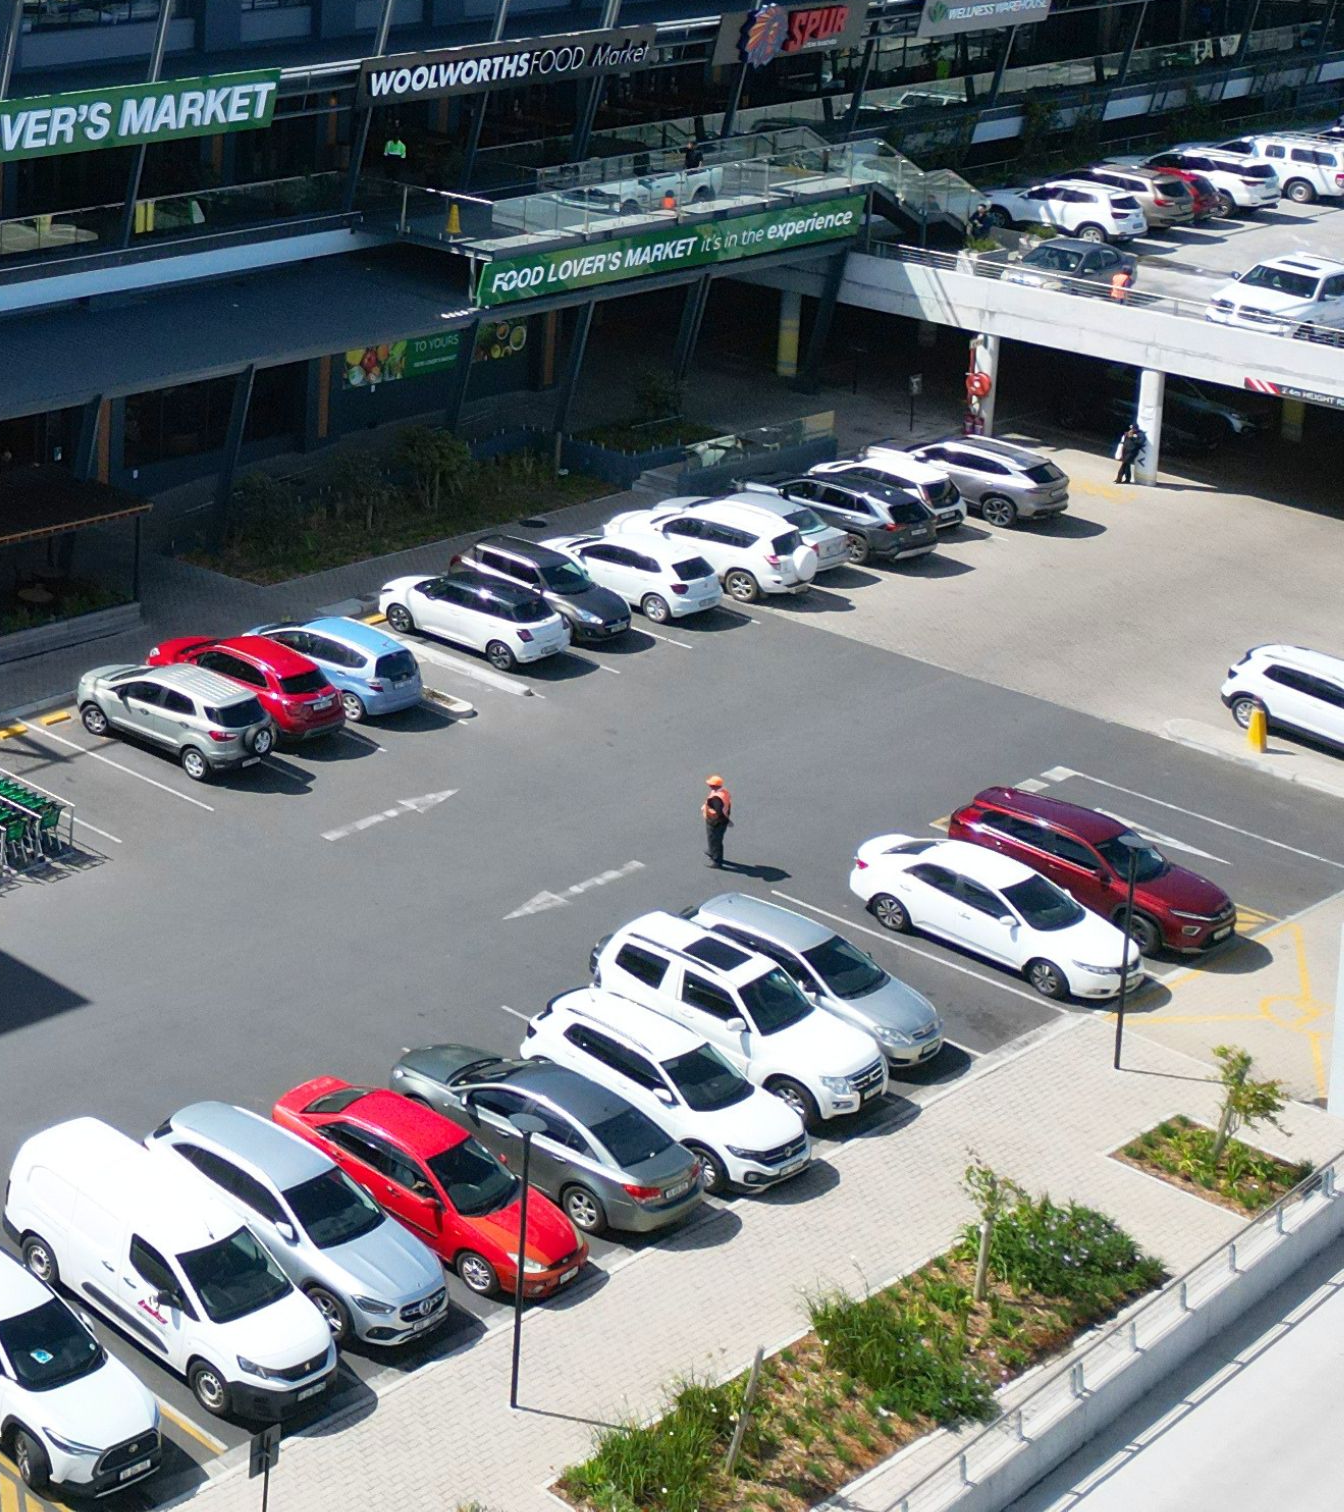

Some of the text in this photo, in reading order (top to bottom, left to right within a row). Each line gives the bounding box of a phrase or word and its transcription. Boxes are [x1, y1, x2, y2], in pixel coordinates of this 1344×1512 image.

[782, 5, 849, 52] SPUR
[948, 3, 995, 21] WELLNESS
[592, 41, 650, 66] Market
[118, 82, 276, 136] MARKET
[492, 266, 544, 293] FOOD
[547, 251, 622, 283] LOVER'S
[624, 237, 698, 268] MARKET
[724, 232, 738, 248] in
[741, 228, 763, 245] the
[767, 210, 853, 241] experience
[414, 340, 427, 353] TO
